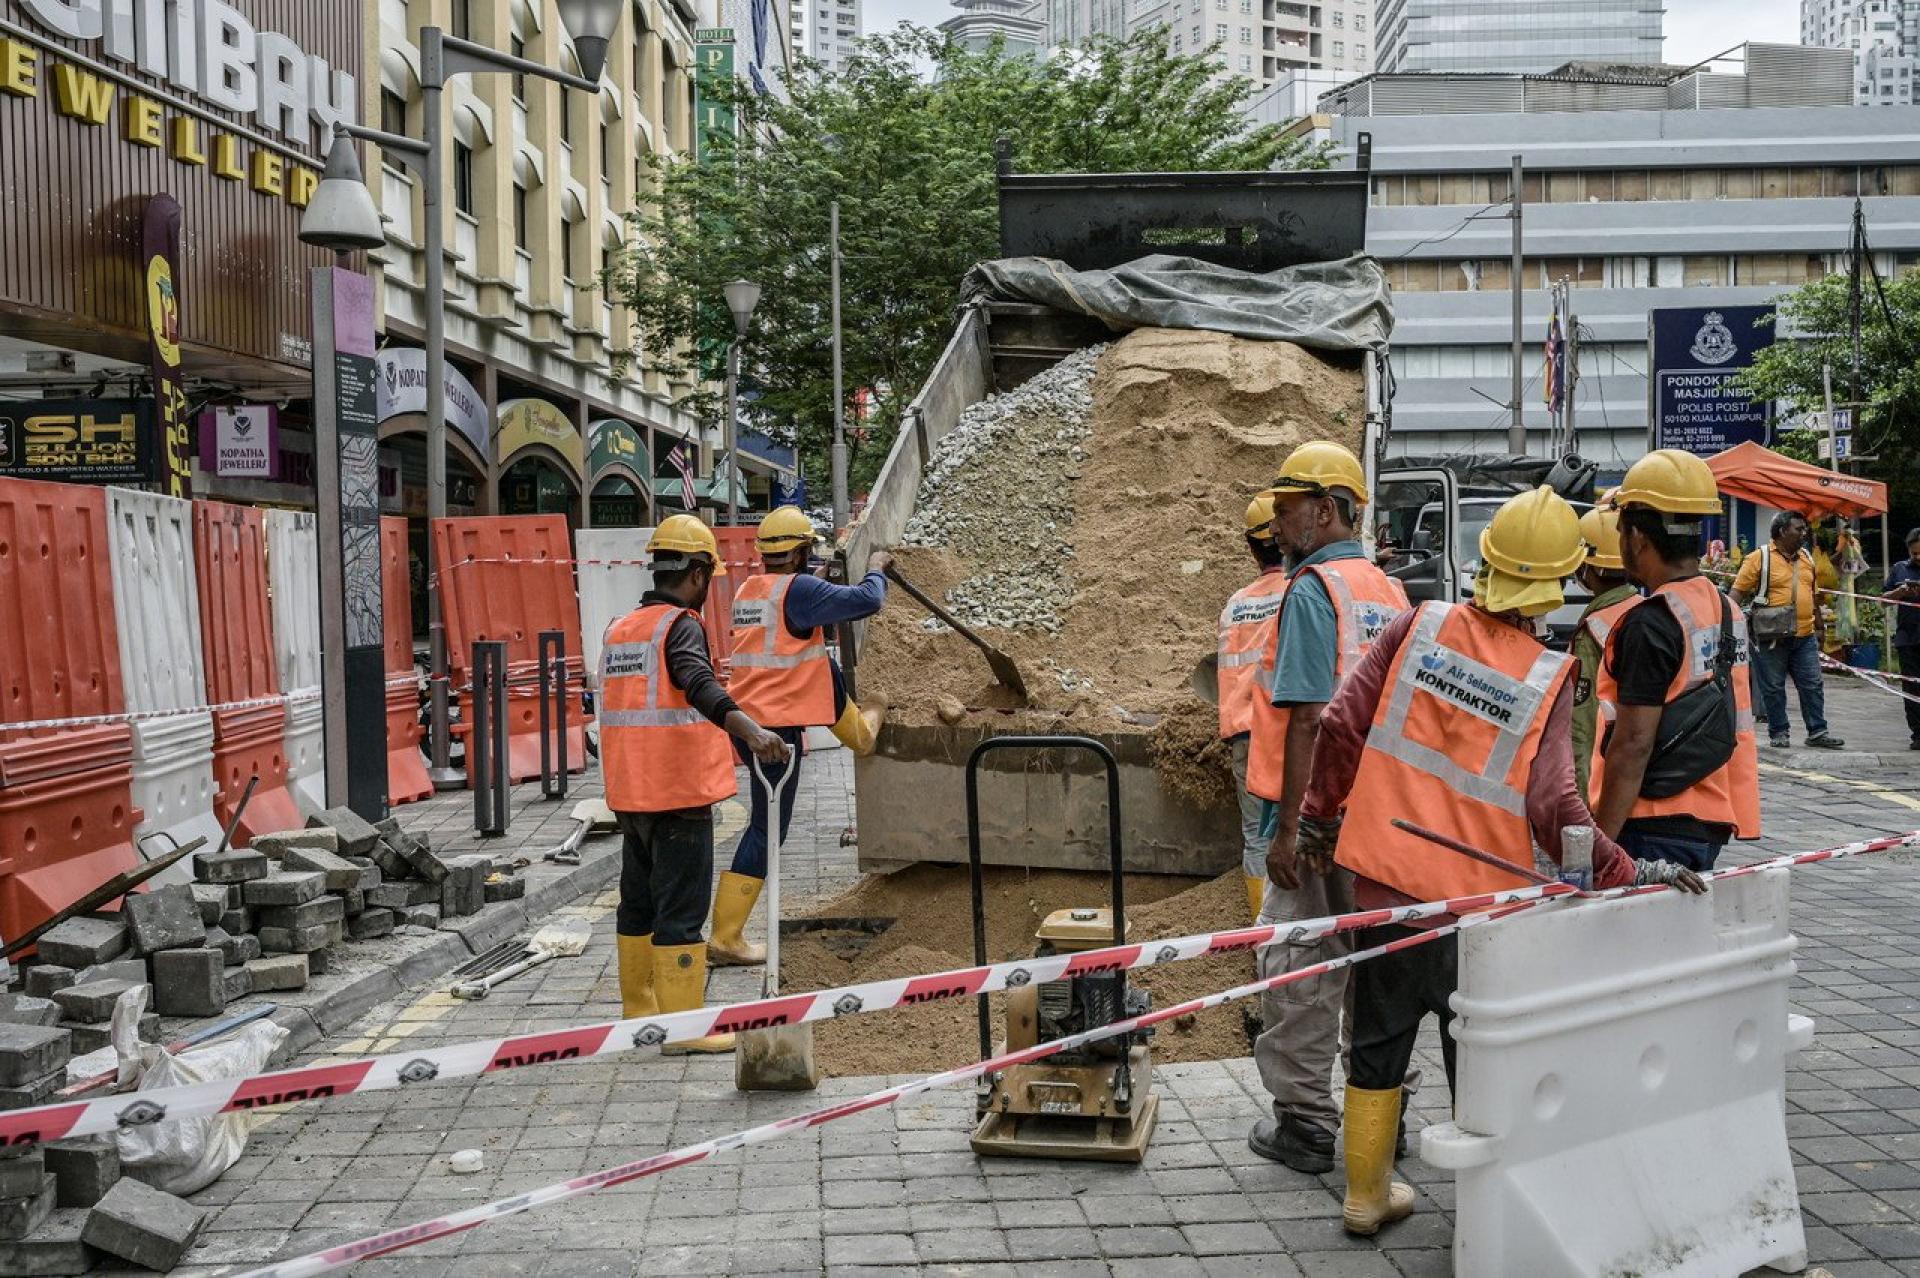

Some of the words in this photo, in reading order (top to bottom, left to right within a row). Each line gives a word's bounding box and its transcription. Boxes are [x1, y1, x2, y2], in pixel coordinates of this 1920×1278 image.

[698, 29, 733, 40] HOTEL
[1667, 376, 1720, 387] PONDOK
[1674, 388, 1720, 399] MASJID
[1677, 402, 1714, 413] (POLIS
[1716, 402, 1750, 413] POST)
[1664, 414, 1690, 424] 50100
[1691, 414, 1722, 423] KUALA
[1724, 413, 1762, 422] LUMPUR
[23, 414, 136, 443] SH
[25, 442, 136, 455] BULLION
[220, 448, 265, 459] KOPATHA
[26, 454, 78, 466] SDN
[85, 453, 136, 464] BHD
[219, 459, 267, 471] JEWELLERS
[1446, 665, 1466, 680] Air
[1466, 673, 1519, 704] Selangor
[1415, 668, 1512, 723] KONTRAKTOR
